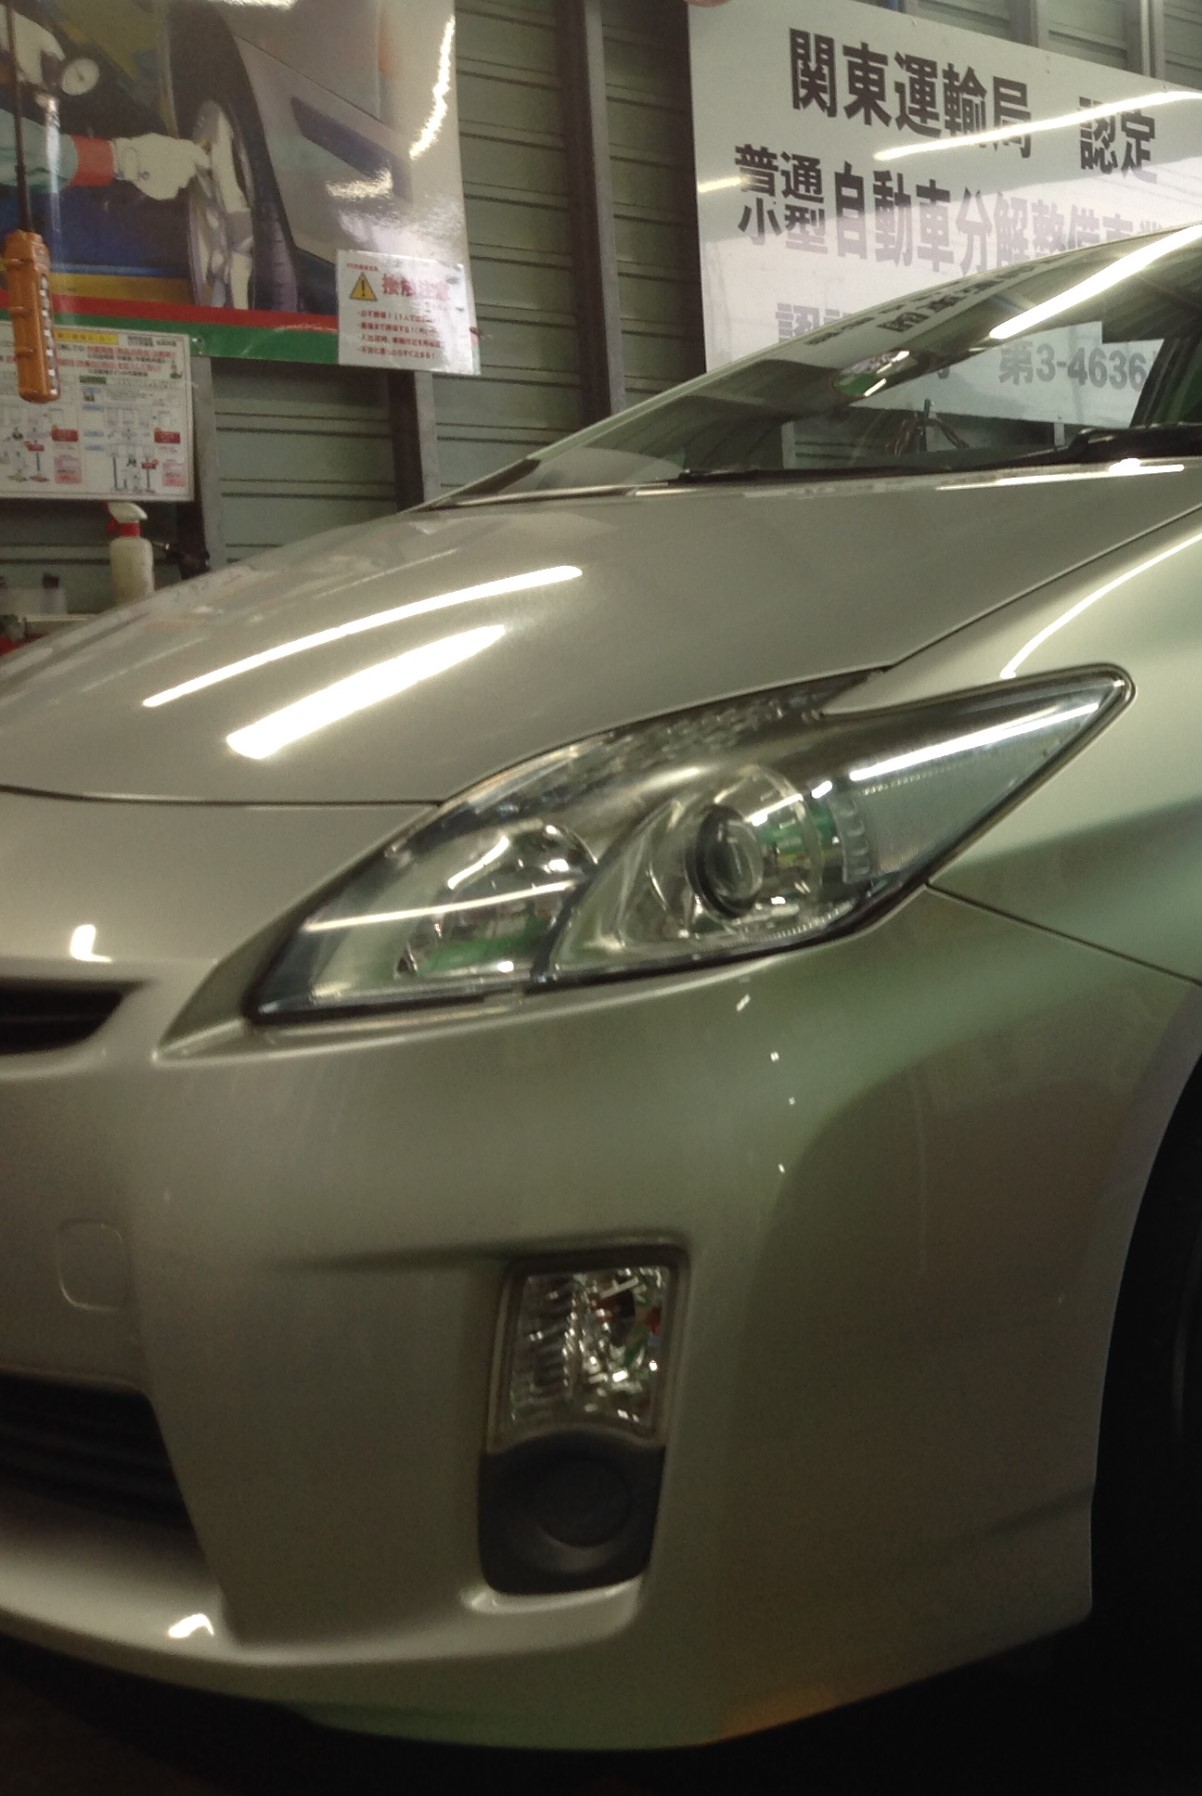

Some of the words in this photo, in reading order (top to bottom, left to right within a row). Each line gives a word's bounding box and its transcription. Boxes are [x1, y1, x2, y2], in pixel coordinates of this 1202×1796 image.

[789, 27, 1033, 159] 関東運輸局
[1077, 96, 1158, 184] 認定
[734, 143, 825, 204] 普通
[737, 197, 828, 255] 小型
[833, 161, 1162, 276] 自動車分解整備事
